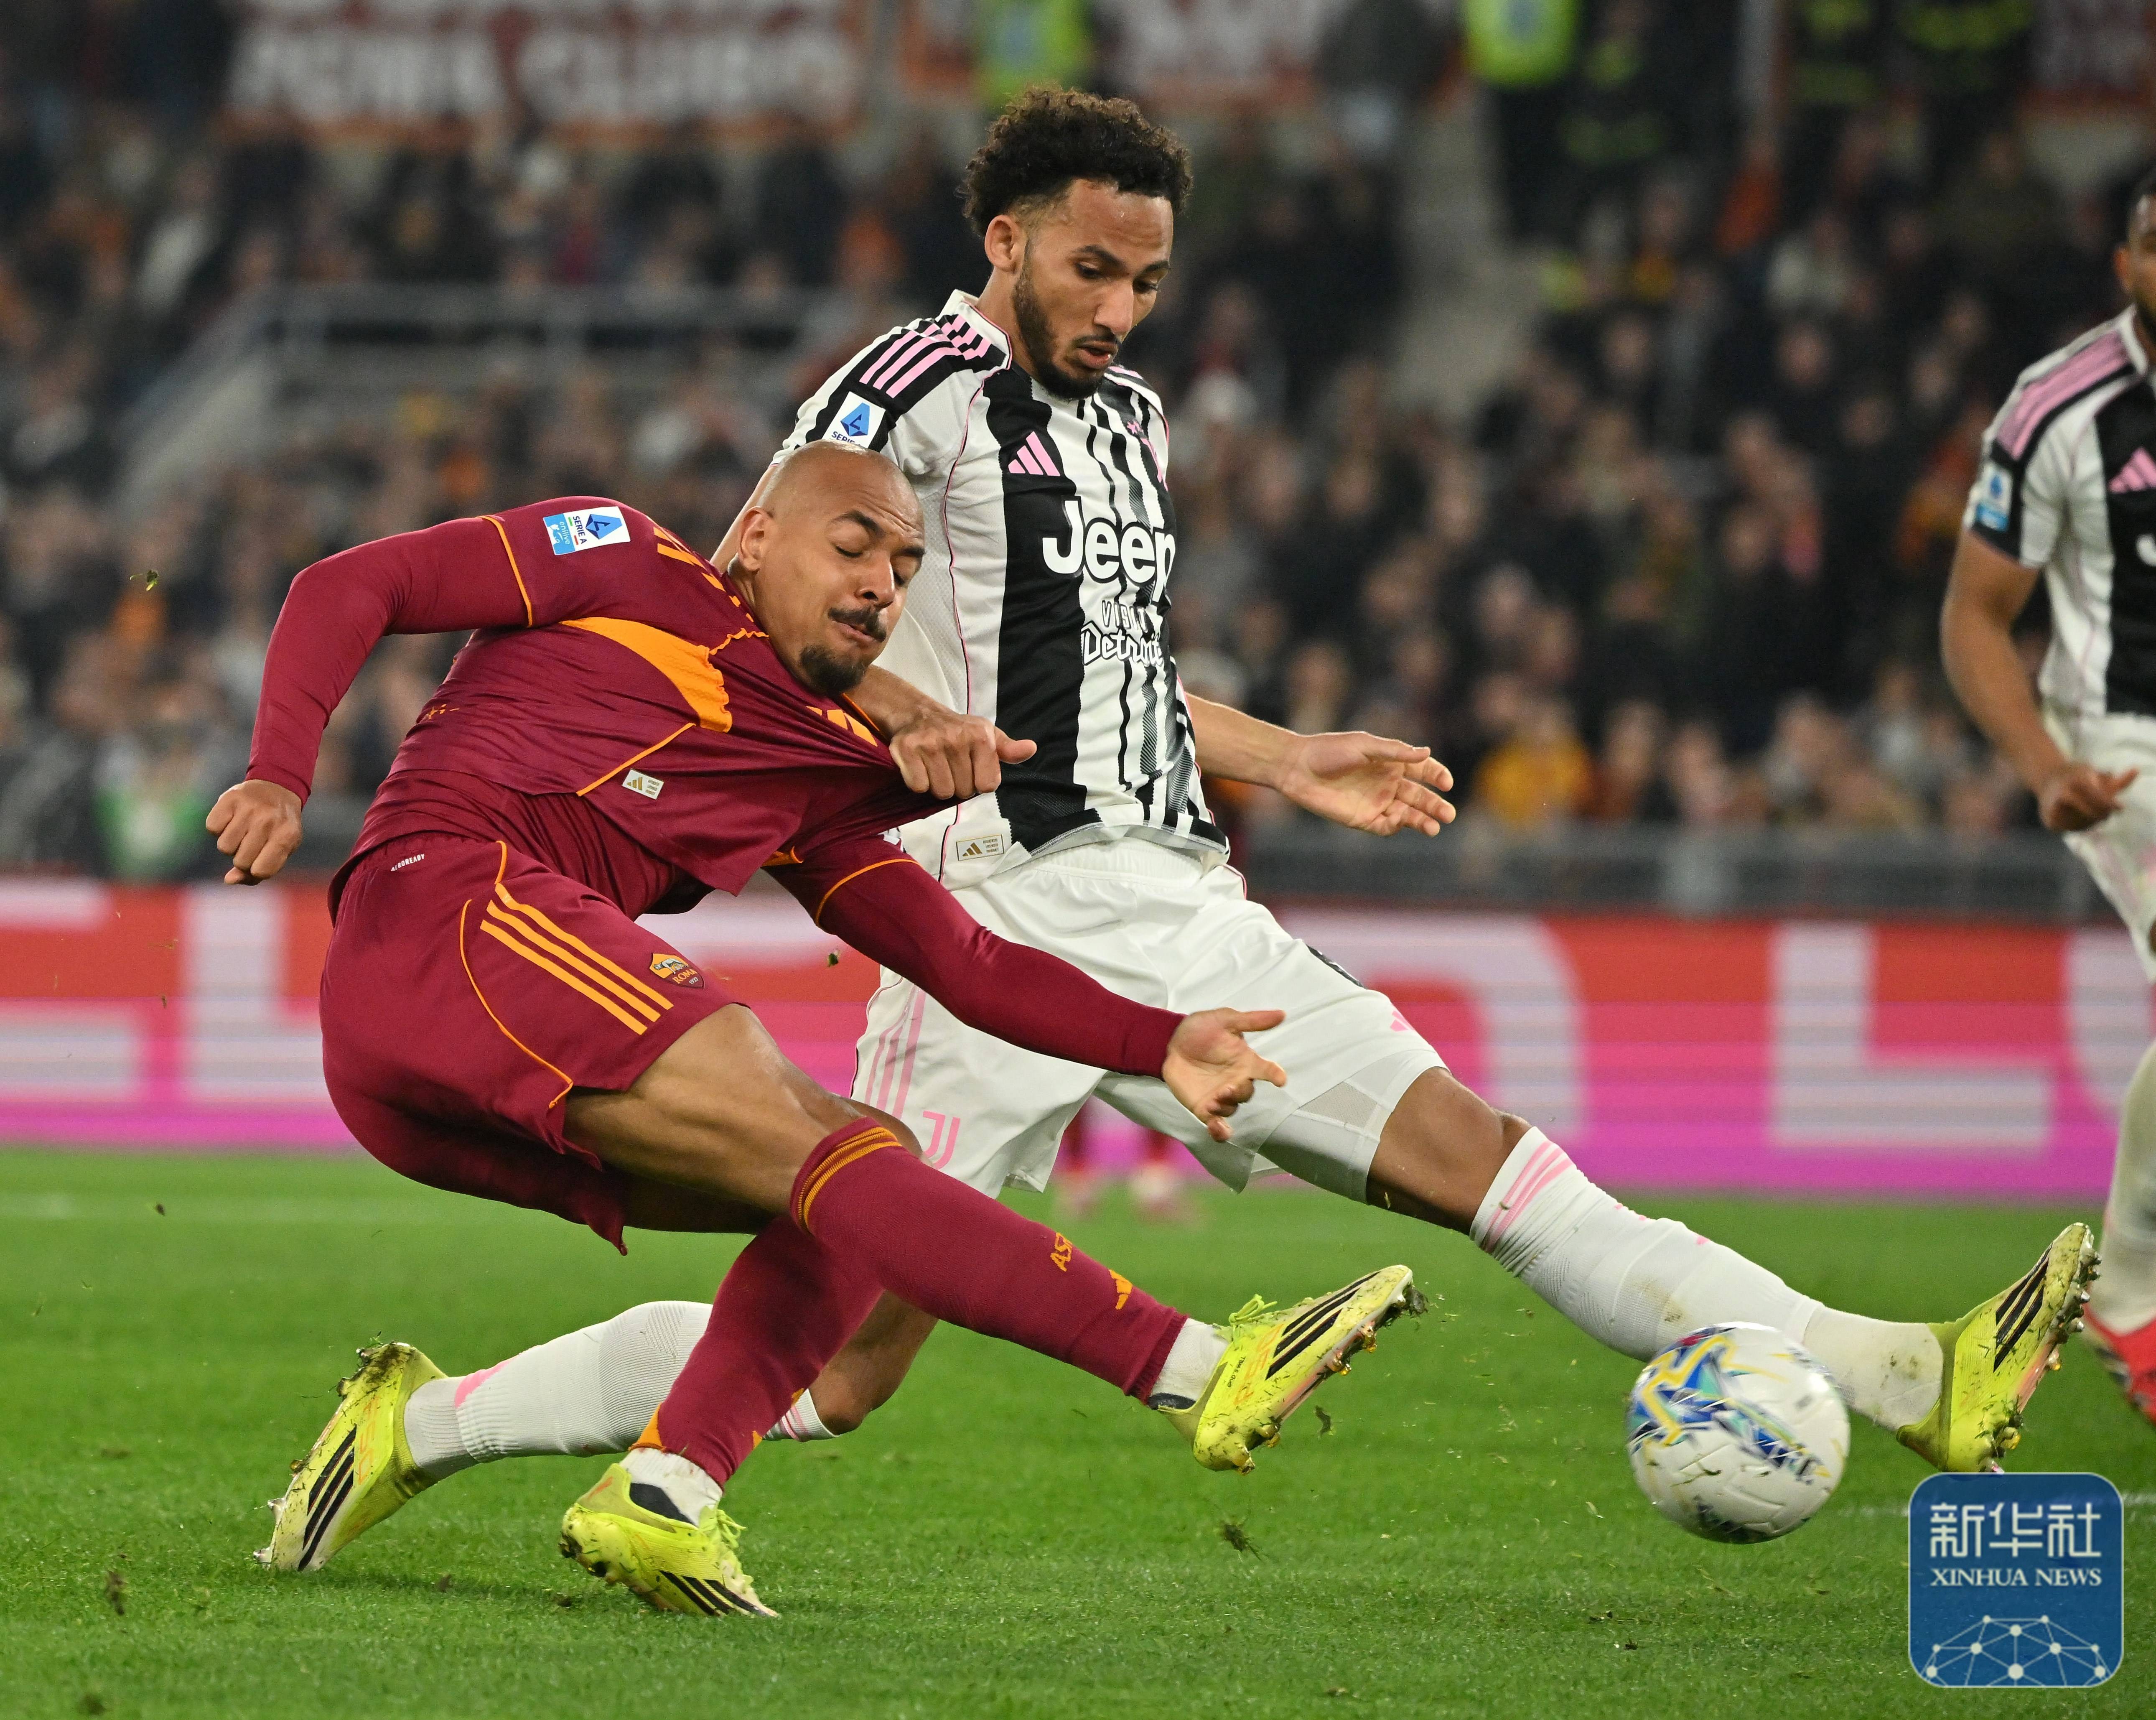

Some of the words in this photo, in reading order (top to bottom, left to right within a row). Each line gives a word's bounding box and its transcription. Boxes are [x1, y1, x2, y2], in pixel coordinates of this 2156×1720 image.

[559, 521, 570, 545] enilive
[573, 516, 585, 537] SERIE
[1042, 500, 1176, 603] Jeep
[1102, 600, 1148, 633] VISIT
[1081, 620, 1164, 666] Detroit
[391, 854, 425, 871] AEROREADY
[672, 968, 698, 984] ROMA
